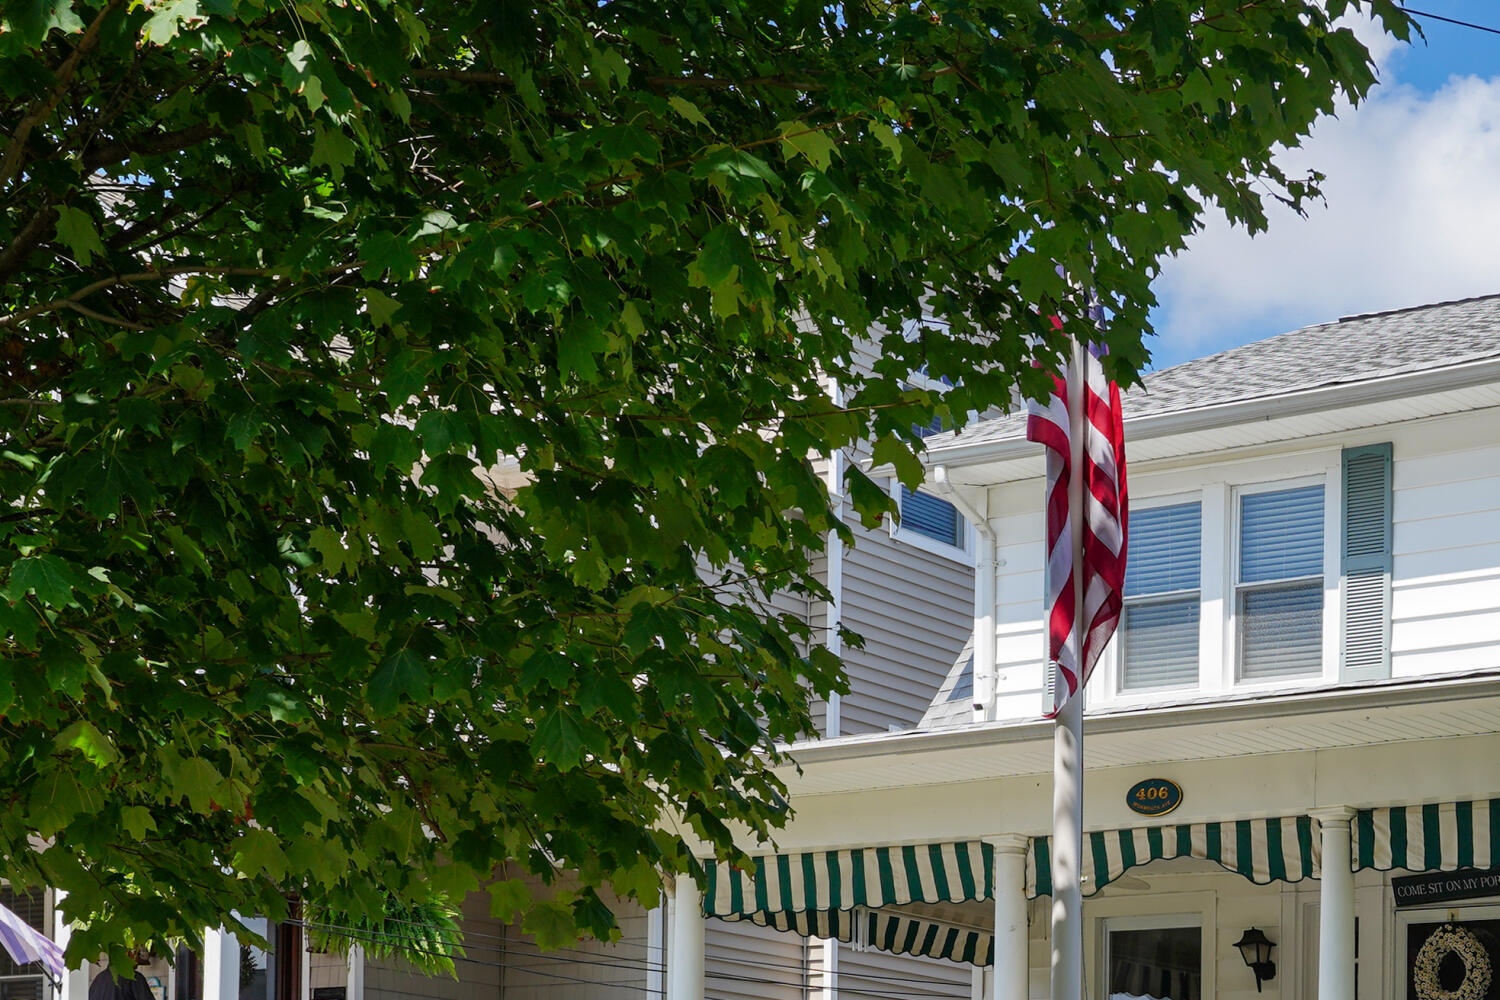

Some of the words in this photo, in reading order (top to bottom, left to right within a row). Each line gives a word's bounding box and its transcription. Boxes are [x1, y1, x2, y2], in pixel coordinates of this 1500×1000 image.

[1136, 786, 1168, 800] 406
[1397, 884, 1427, 897] COME
[1428, 881, 1443, 894] SIT
[1446, 880, 1462, 892] ON
[1463, 878, 1478, 890] MY
